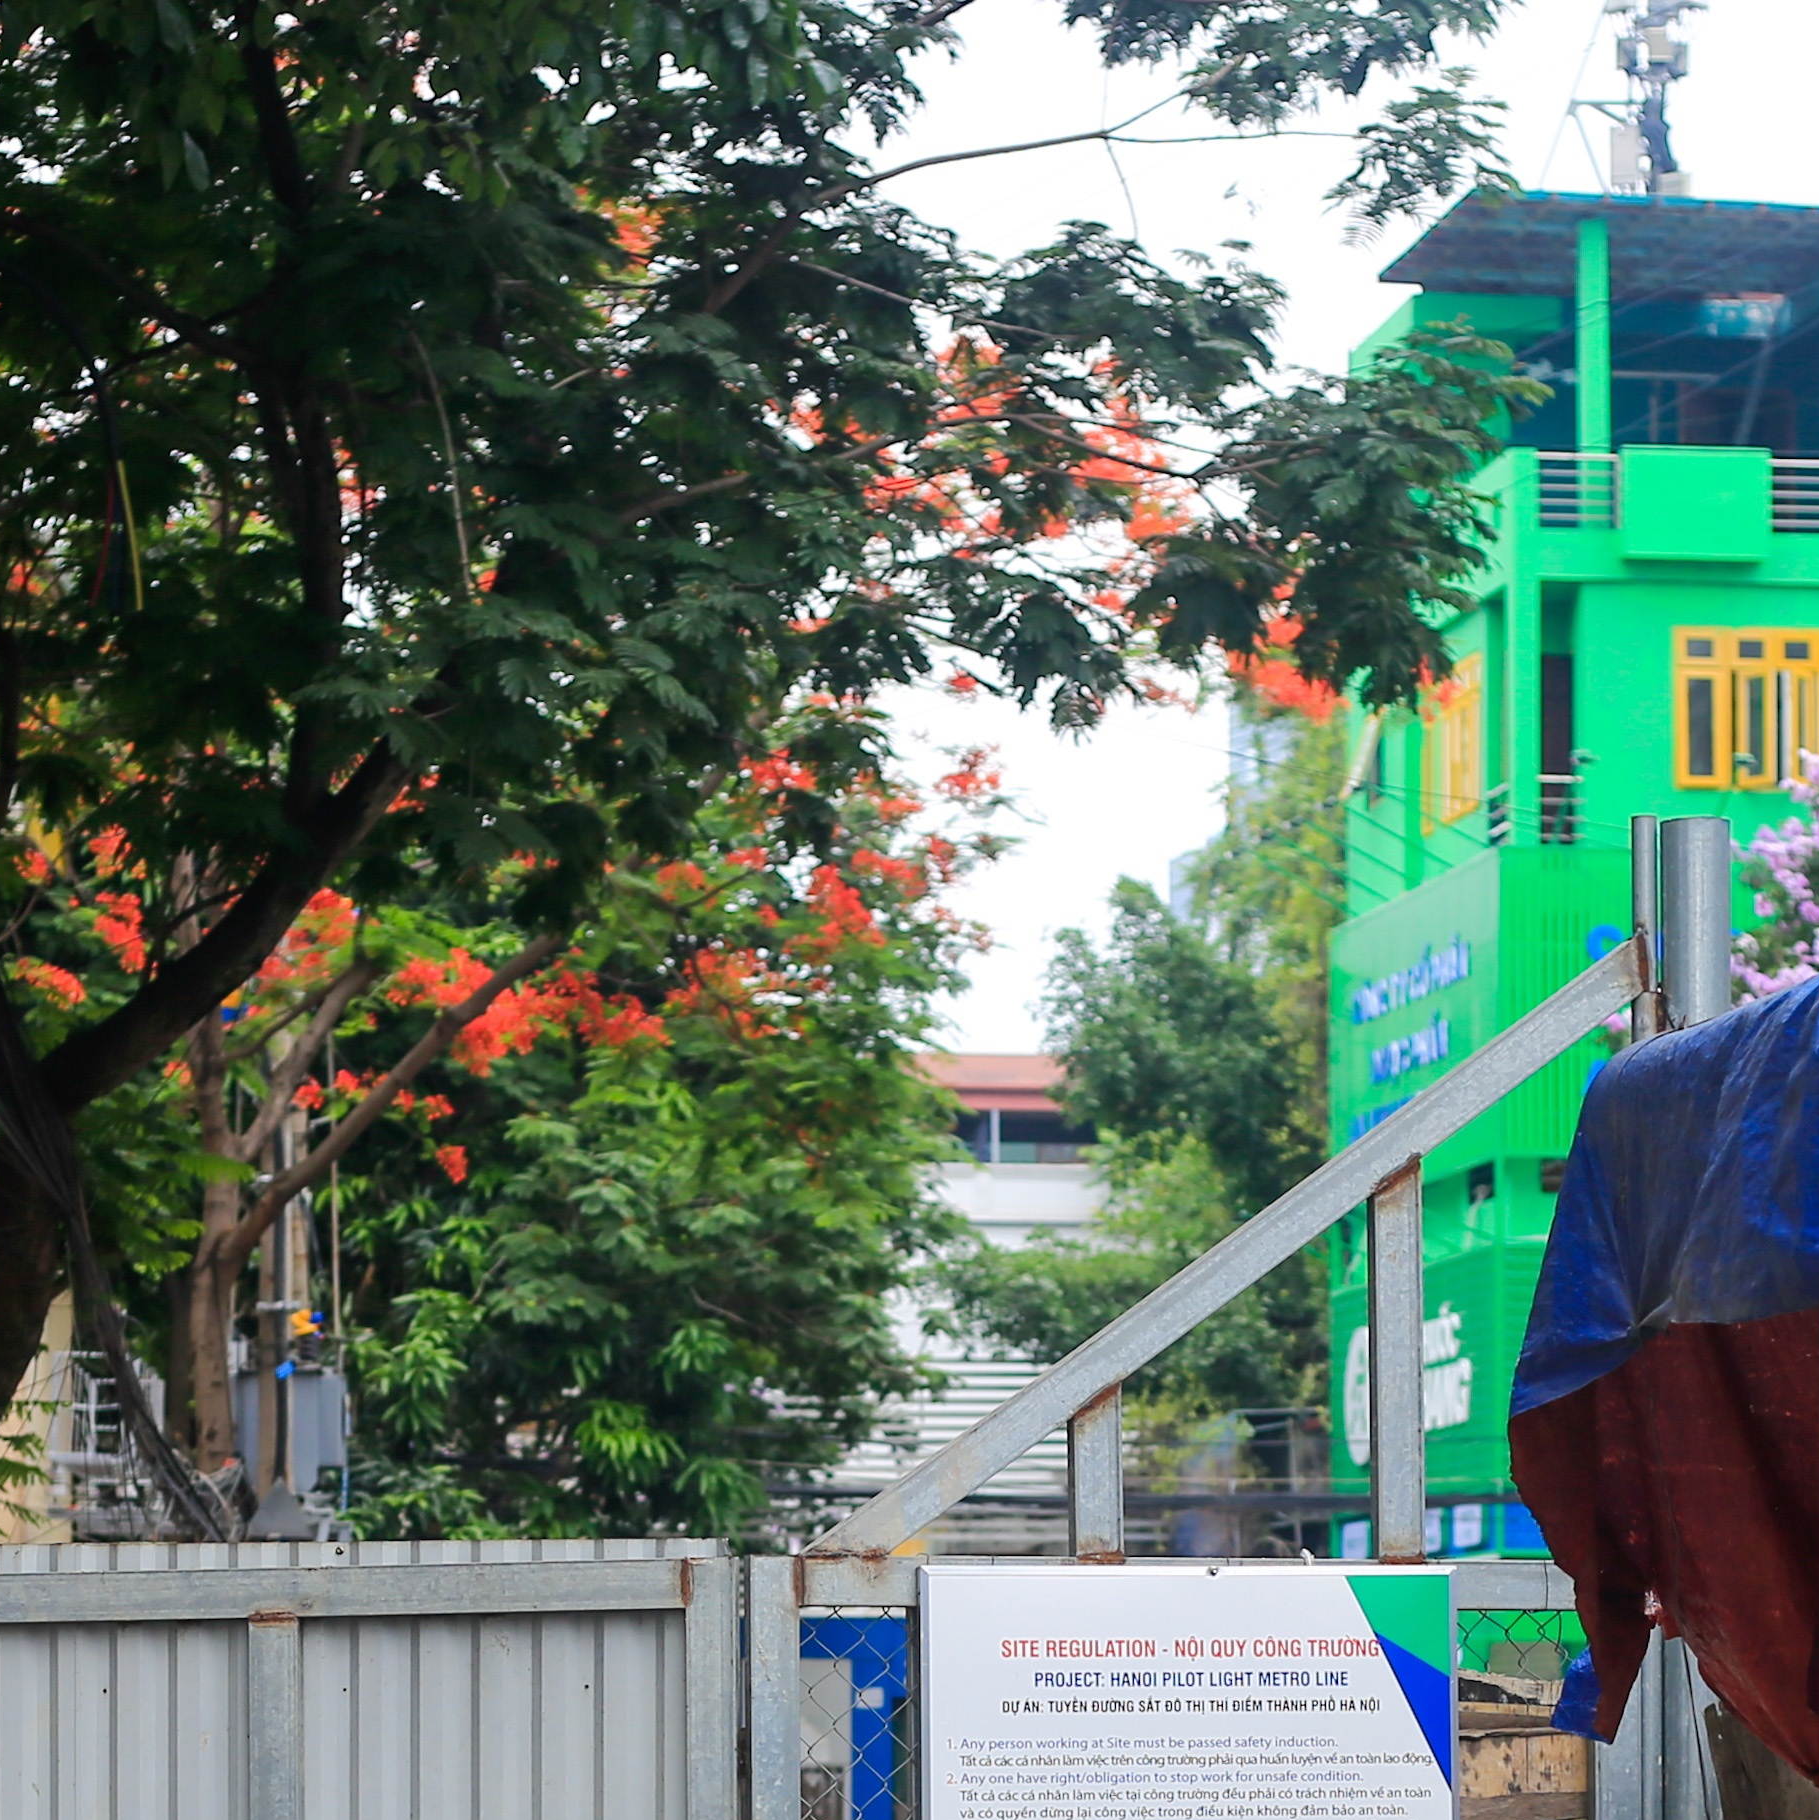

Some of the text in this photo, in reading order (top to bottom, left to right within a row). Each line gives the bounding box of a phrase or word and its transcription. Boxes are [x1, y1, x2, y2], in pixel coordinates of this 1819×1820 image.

[1000, 1639, 1039, 1657] SITE
[1045, 1639, 1156, 1657] REGULATION
[1174, 1636, 1204, 1659] NỘI
[1210, 1639, 1246, 1658] QUY
[1252, 1636, 1302, 1657] CÔNG
[1034, 1671, 1348, 1687] PROJECT: HANOI PILOT LIGHT METRO LINE
[959, 1738, 986, 1752] Any
[988, 1740, 1033, 1751] person
[1035, 1737, 1088, 1751] working
[1090, 1738, 1104, 1748] at
[1106, 1736, 1131, 1748] Site
[1133, 1738, 1165, 1748] must
[1168, 1736, 1185, 1748] be
[1187, 1736, 1231, 1750] passed
[1234, 1735, 1272, 1750] safety
[960, 1772, 986, 1786] Any
[988, 1775, 1014, 1784] one
[1016, 1772, 1048, 1783] have
[1153, 1772, 1168, 1783] to
[1170, 1772, 1198, 1785] stop
[1200, 1770, 1233, 1782] work
[1235, 1769, 1253, 1782] for
[1255, 1770, 1298, 1782] unsafe
